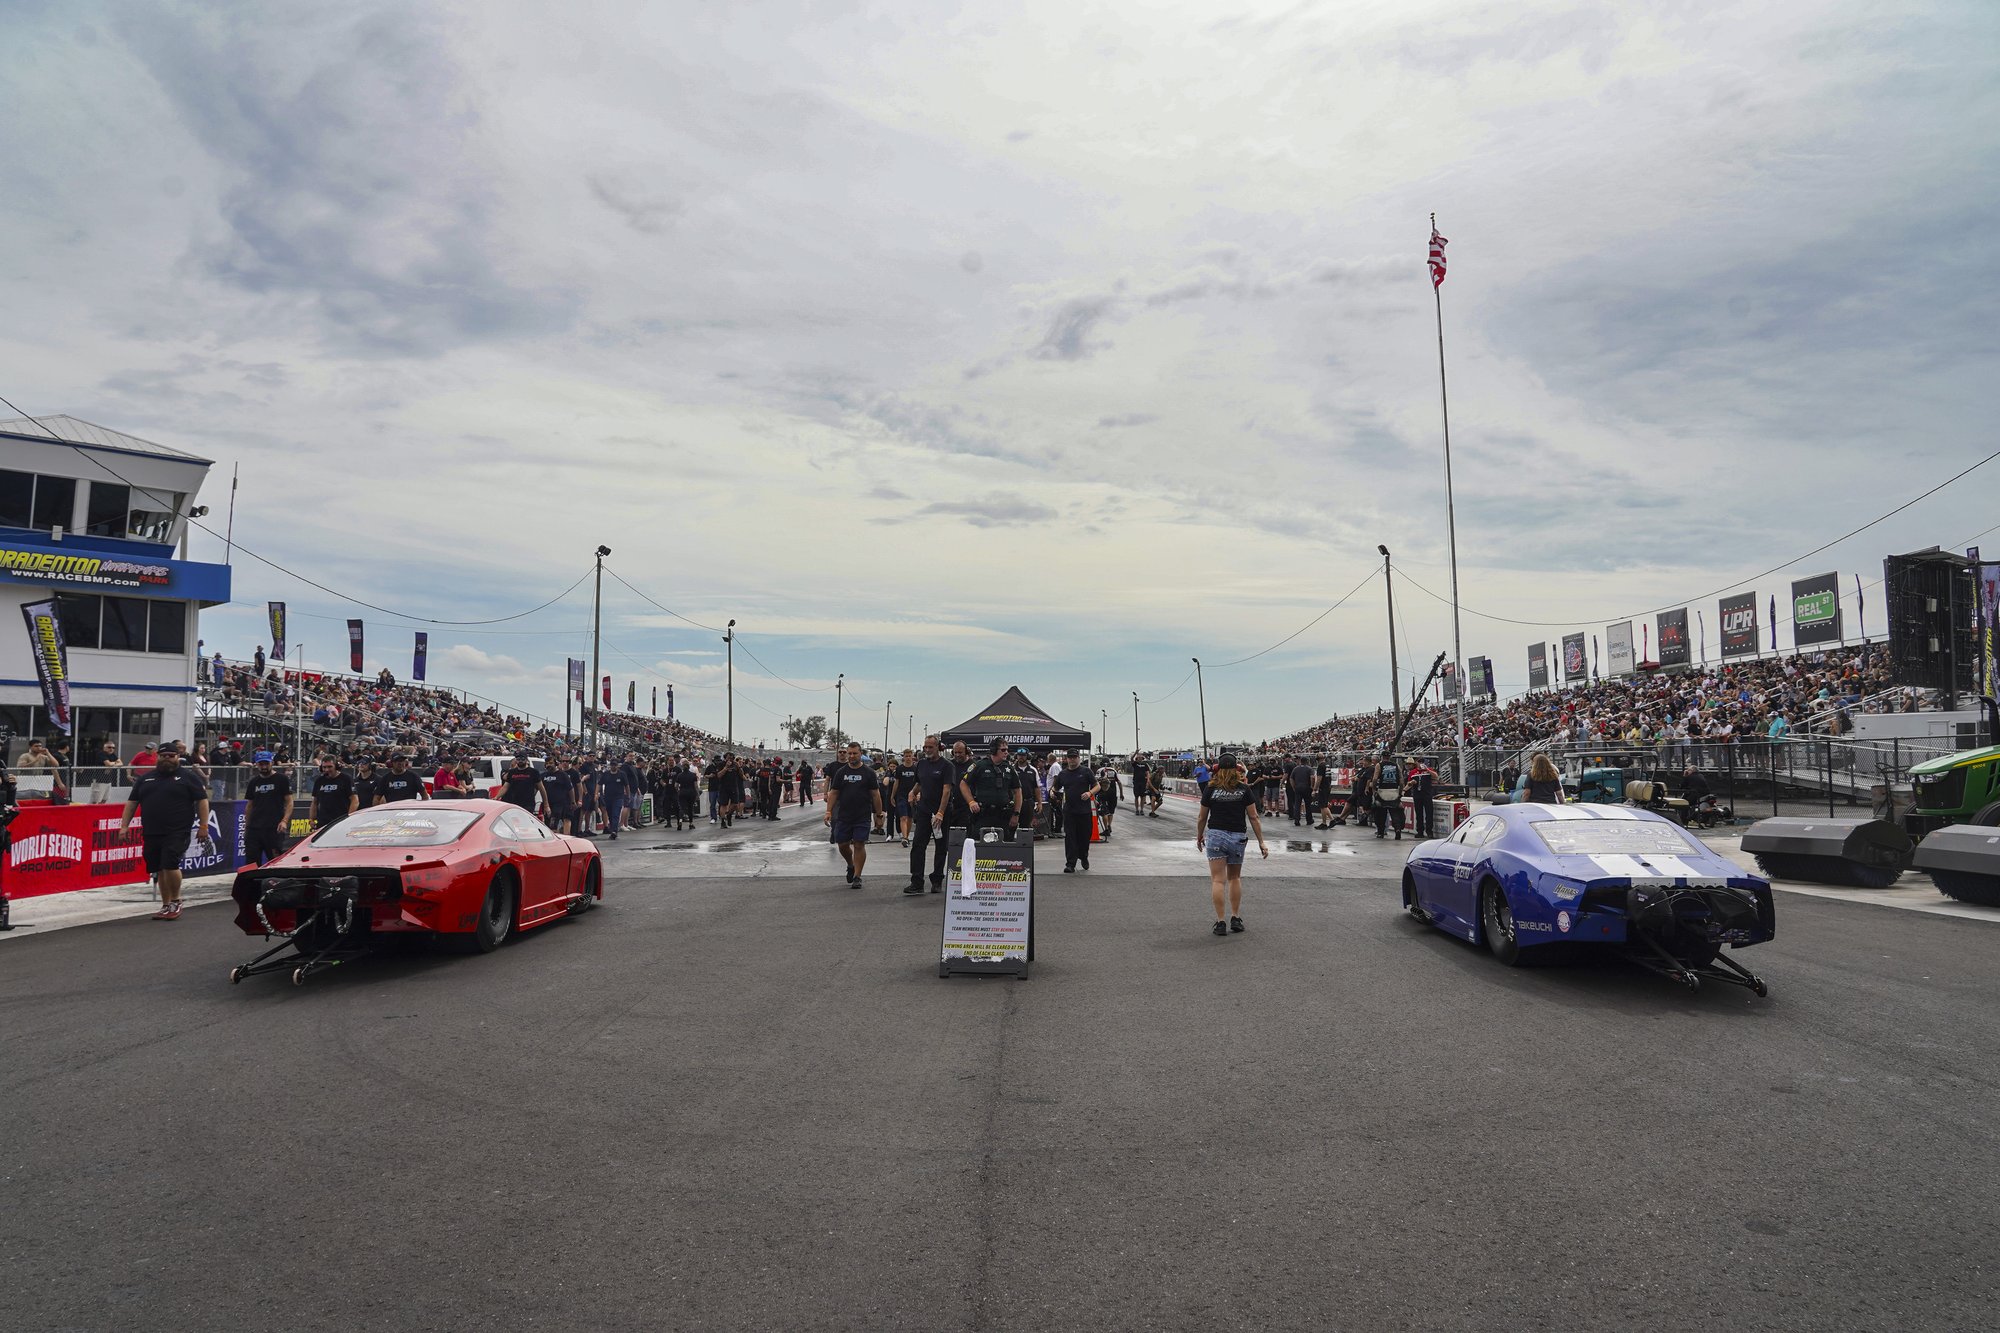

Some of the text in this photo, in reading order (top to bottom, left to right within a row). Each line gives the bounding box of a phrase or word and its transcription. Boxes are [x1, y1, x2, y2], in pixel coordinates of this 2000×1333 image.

[0, 550, 101, 576] RADENTON
[11, 570, 140, 587] www.RACEBMP.com
[139, 575, 169, 585] PARK
[1798, 596, 1830, 618] REAL ST
[1723, 609, 1753, 632] UPR
[34, 615, 65, 680] BRADENTON
[983, 735, 1050, 743] WRACEBMP.COM
[11, 834, 82, 867] WORLD SERIES
[20, 860, 72, 873] PRO MOD
[179, 853, 224, 870] ERVICE
[956, 859, 997, 867] BENTON
[1006, 874, 1027, 882] AREA
